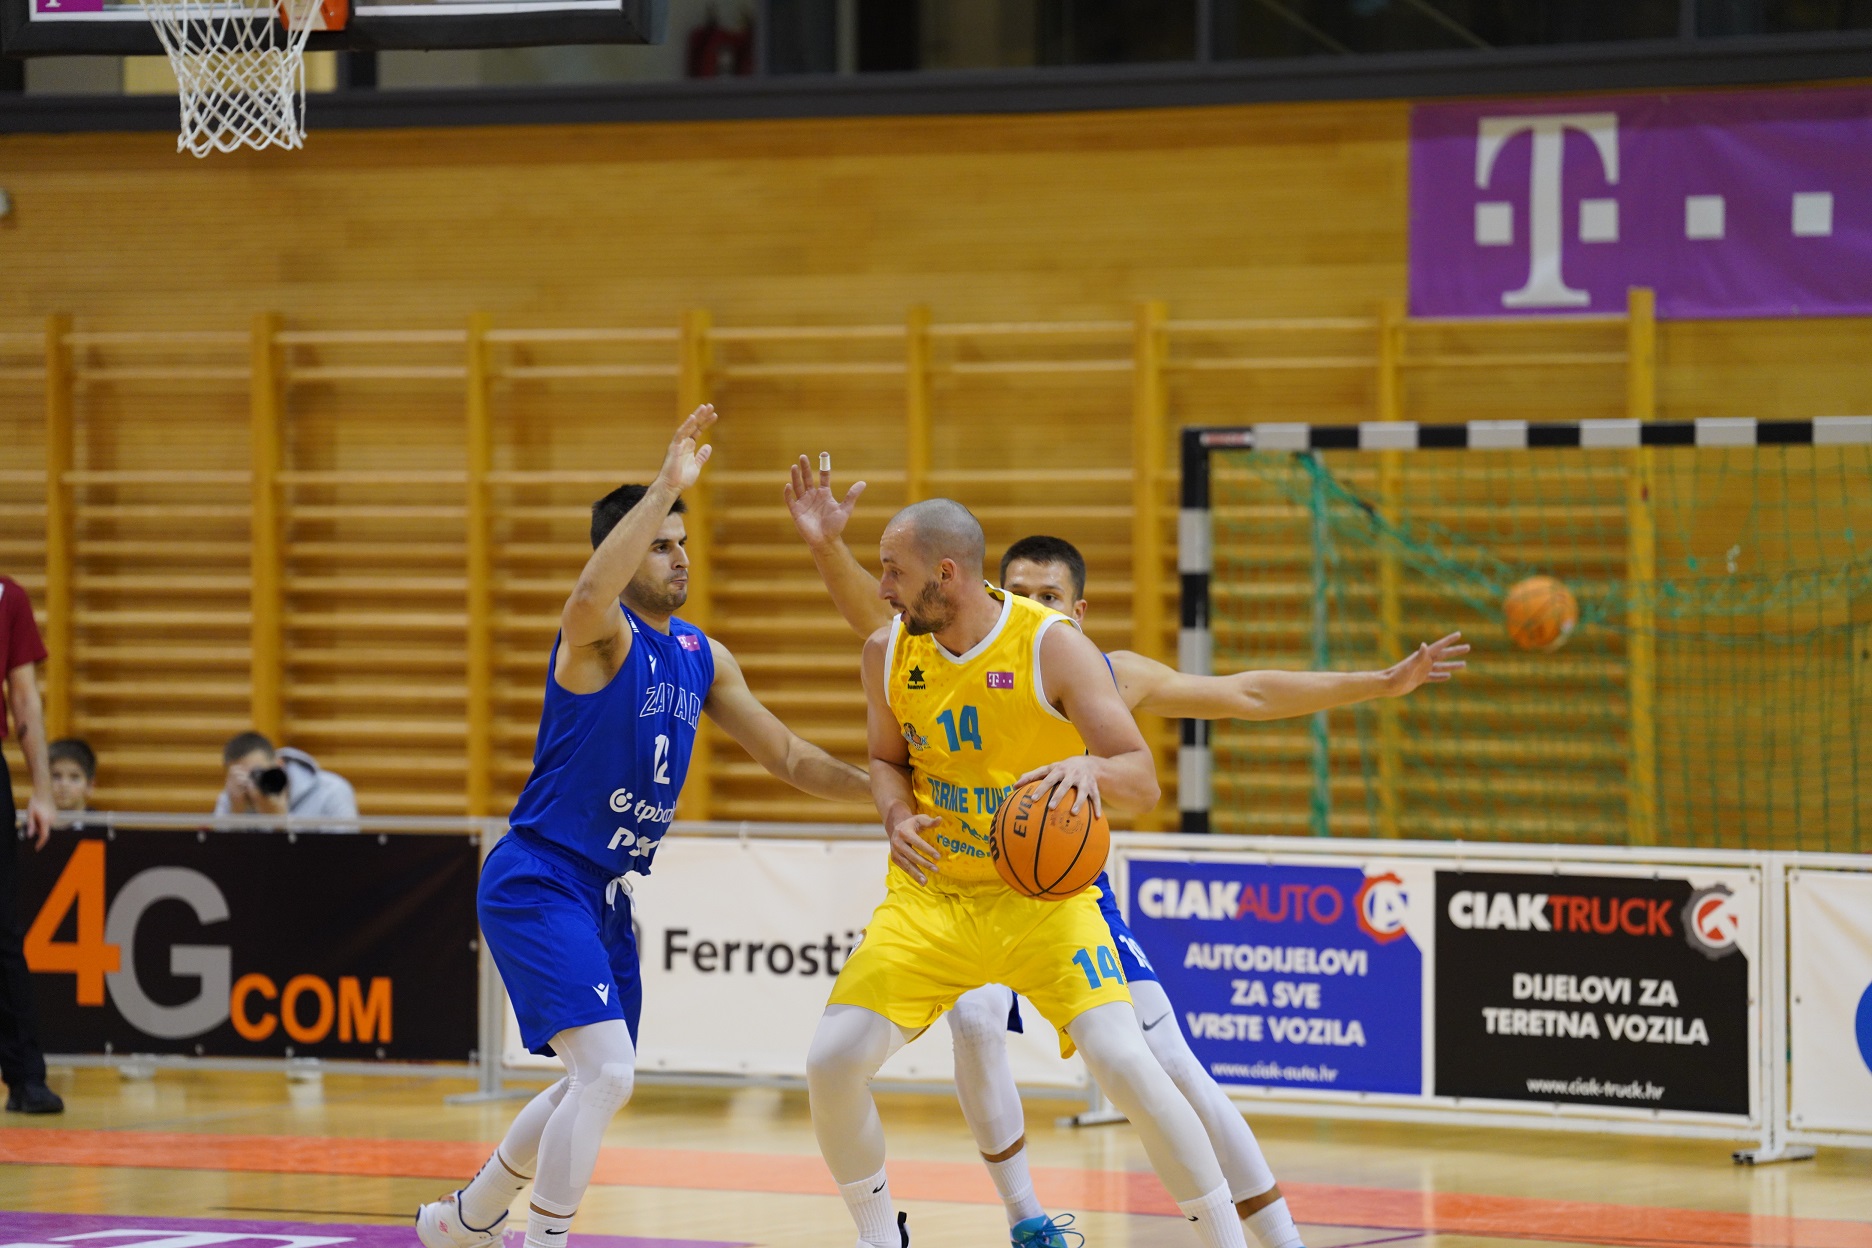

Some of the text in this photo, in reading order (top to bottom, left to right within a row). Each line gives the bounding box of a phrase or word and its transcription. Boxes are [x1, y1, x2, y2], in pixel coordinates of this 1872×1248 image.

[936, 704, 983, 752] 14
[653, 733, 671, 785] 12
[1071, 945, 1124, 990] 14
[1183, 942, 1368, 977] AUTODIJELOVI
[1230, 979, 1322, 1010] ZA SVE
[1512, 972, 1680, 1008] DIJELOVI ZA
[1185, 1011, 1367, 1047] VRSTE VOZILA
[1482, 1006, 1710, 1047] TERETNA VOZILA
